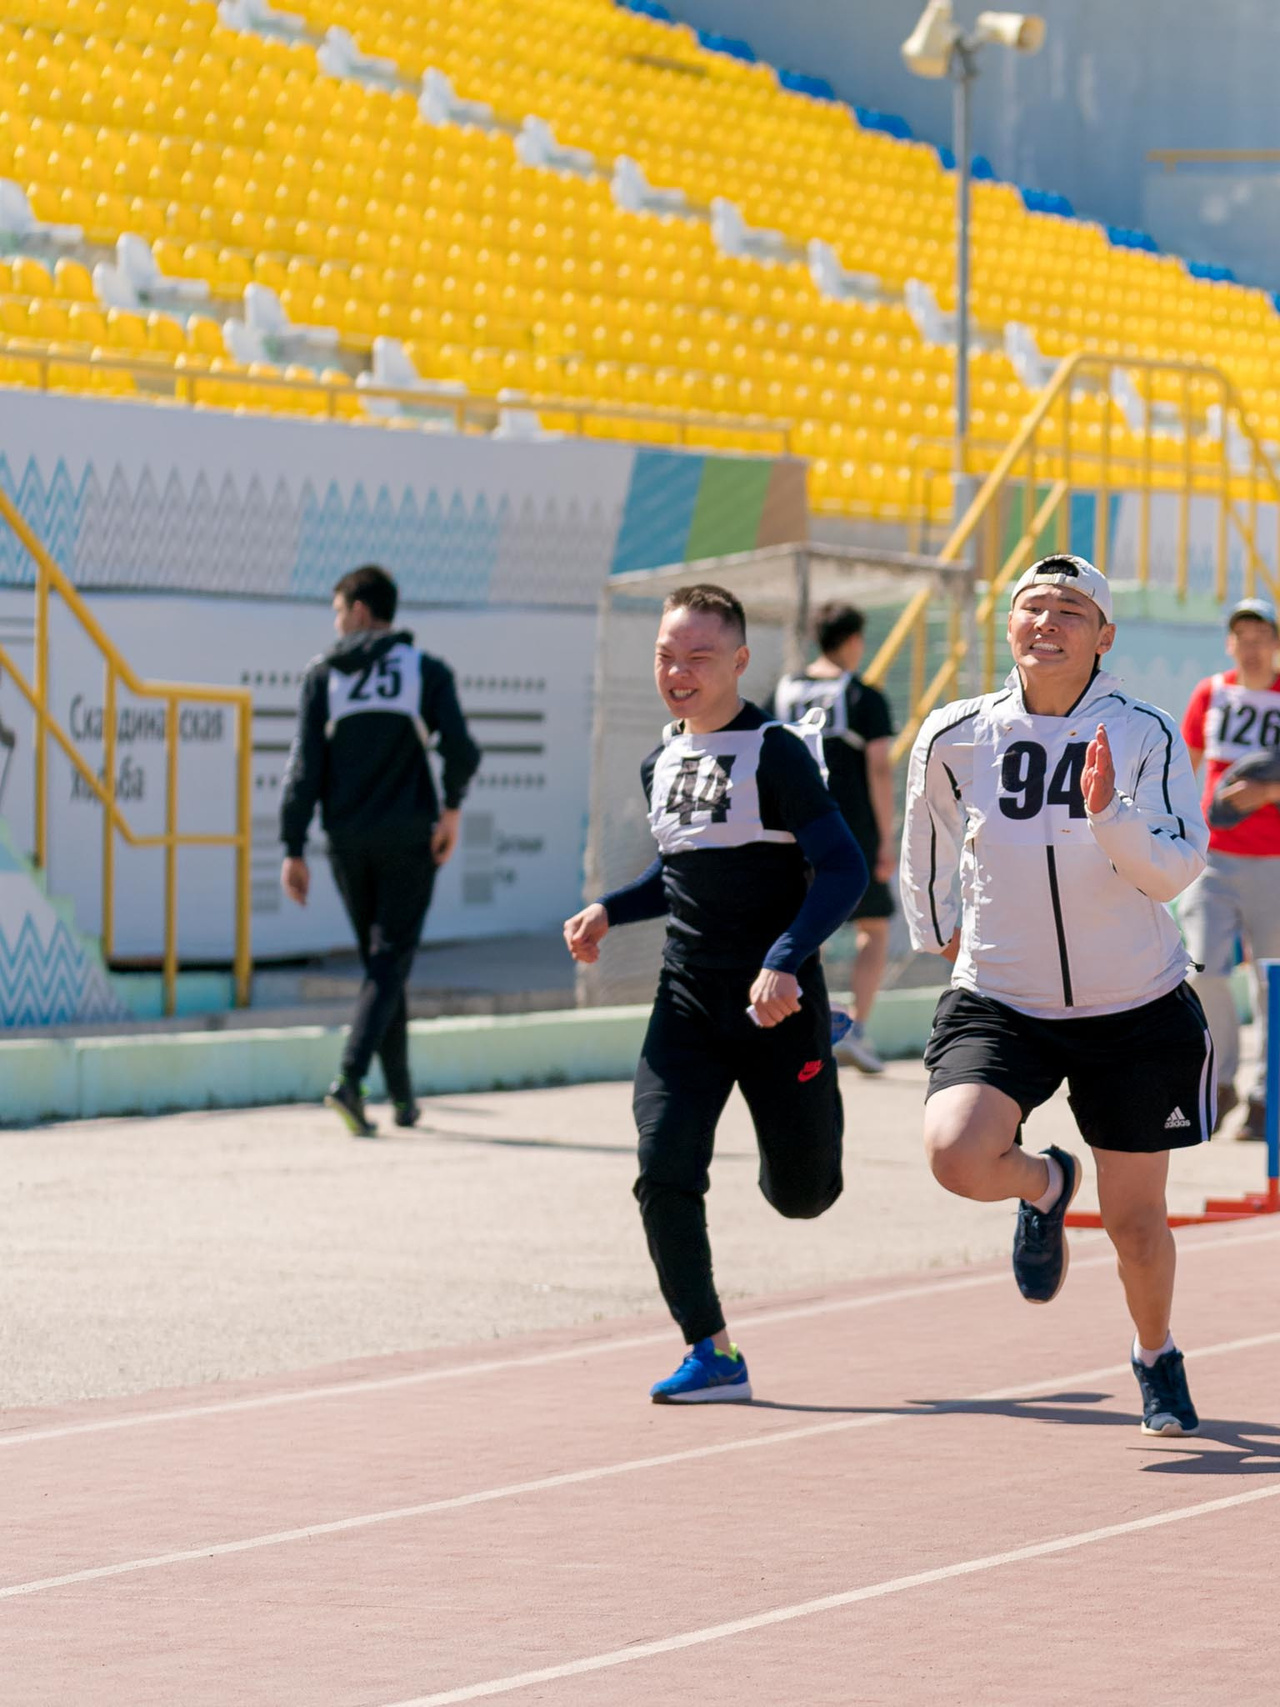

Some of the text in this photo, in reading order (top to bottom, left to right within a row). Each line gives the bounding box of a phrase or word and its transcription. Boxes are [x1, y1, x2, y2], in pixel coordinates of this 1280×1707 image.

[347, 657, 402, 700] 25
[69, 694, 224, 743] Скадинаская
[665, 754, 736, 825] 44
[999, 741, 1089, 820] 94
[1164, 1119, 1190, 1129] adidas
